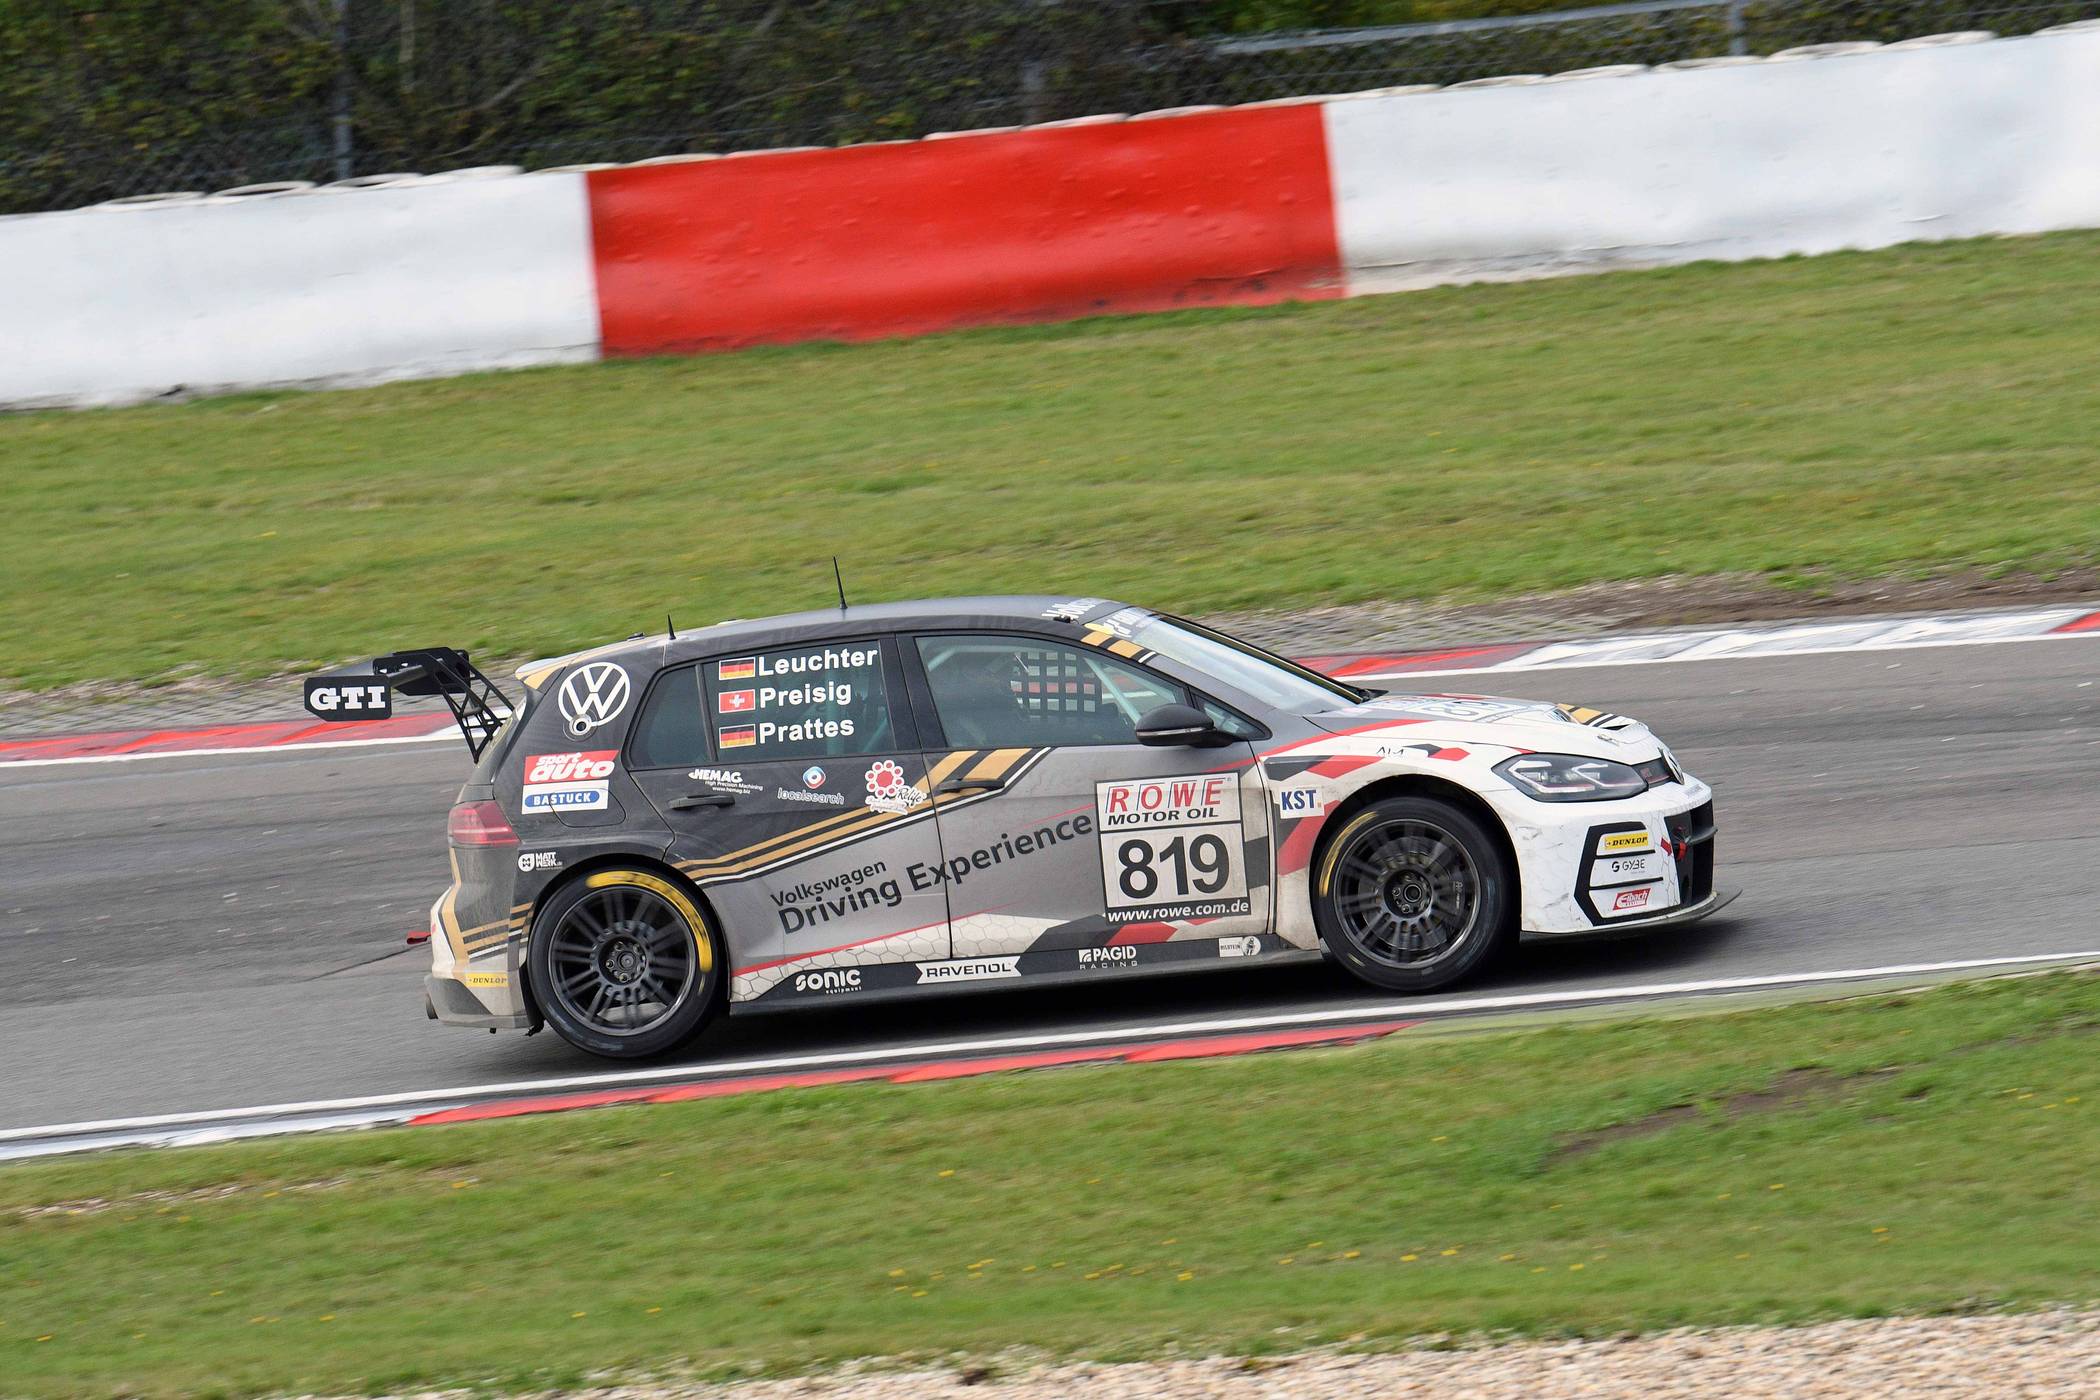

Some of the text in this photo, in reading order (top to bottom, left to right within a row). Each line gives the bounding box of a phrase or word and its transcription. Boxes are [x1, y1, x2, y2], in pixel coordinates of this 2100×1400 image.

[758, 649, 878, 676] Leuchter
[309, 686, 386, 710] GTI
[760, 681, 851, 708] Preisig
[759, 718, 855, 744] Prattes
[536, 752, 582, 767] sport
[529, 759, 615, 782] auto
[688, 769, 743, 783] HEMAG
[533, 792, 591, 806] BASTUCK
[777, 787, 844, 805] localsearch
[1108, 779, 1224, 813] ROWE
[1281, 789, 1317, 810] KST
[1107, 807, 1219, 826] MOTOR OIL
[1612, 836, 1648, 846] DUNLOP
[535, 852, 556, 861] MATT
[1118, 833, 1230, 900] 819
[770, 859, 887, 908] Volkswagen
[777, 878, 903, 936] Driving
[905, 814, 1093, 892] Experience
[1107, 896, 1249, 923] www.rowe.com.de
[1093, 946, 1137, 961] PAGID
[926, 963, 1012, 978] RAVENOL
[1079, 960, 1138, 970] RACING
